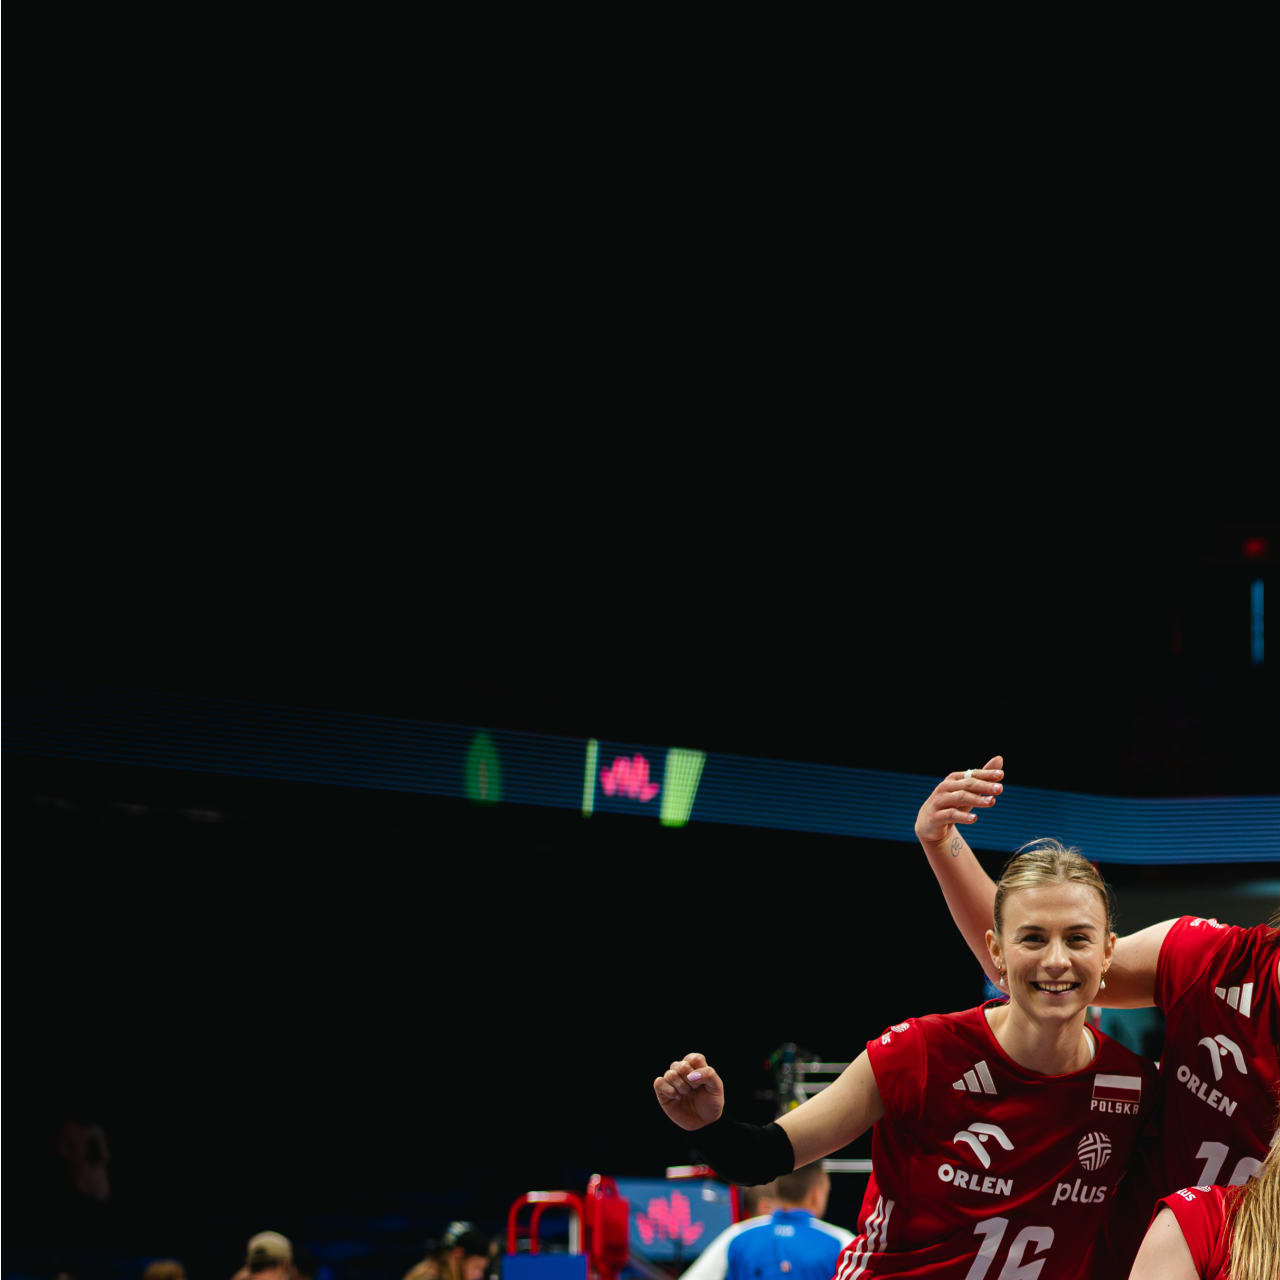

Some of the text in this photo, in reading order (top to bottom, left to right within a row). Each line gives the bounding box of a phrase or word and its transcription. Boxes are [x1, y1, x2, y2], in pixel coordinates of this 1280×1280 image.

[1176, 1065, 1238, 1118] ORLEN
[1090, 1100, 1140, 1115] POLSKA
[937, 1163, 1014, 1197] ORLEN
[1051, 1178, 1108, 1206] plus
[1175, 1187, 1197, 1201] lus
